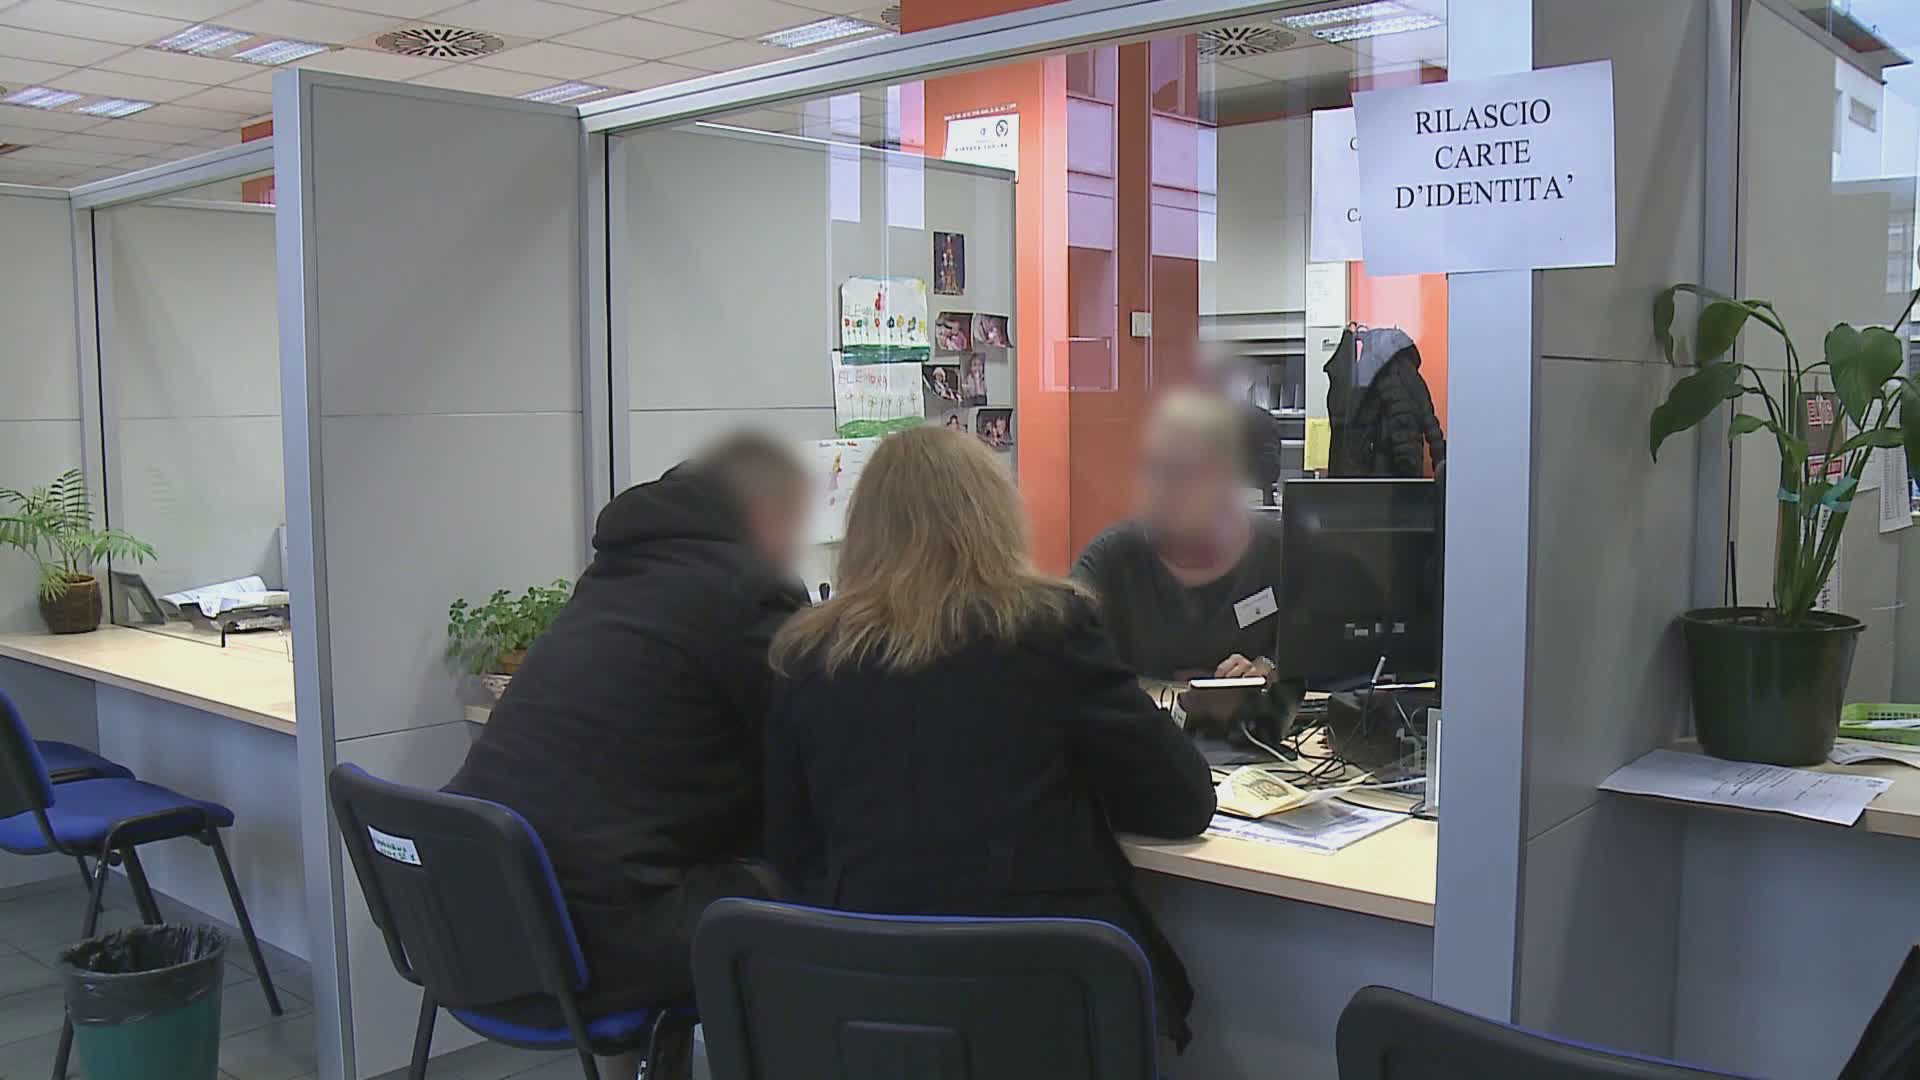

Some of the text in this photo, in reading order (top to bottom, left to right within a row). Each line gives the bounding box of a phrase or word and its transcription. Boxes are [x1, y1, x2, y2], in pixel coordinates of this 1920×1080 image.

[1415, 98, 1551, 135] RILASCIO
[1434, 139, 1531, 170] CARTE
[1395, 174, 1574, 209] D'IDENTITA'
